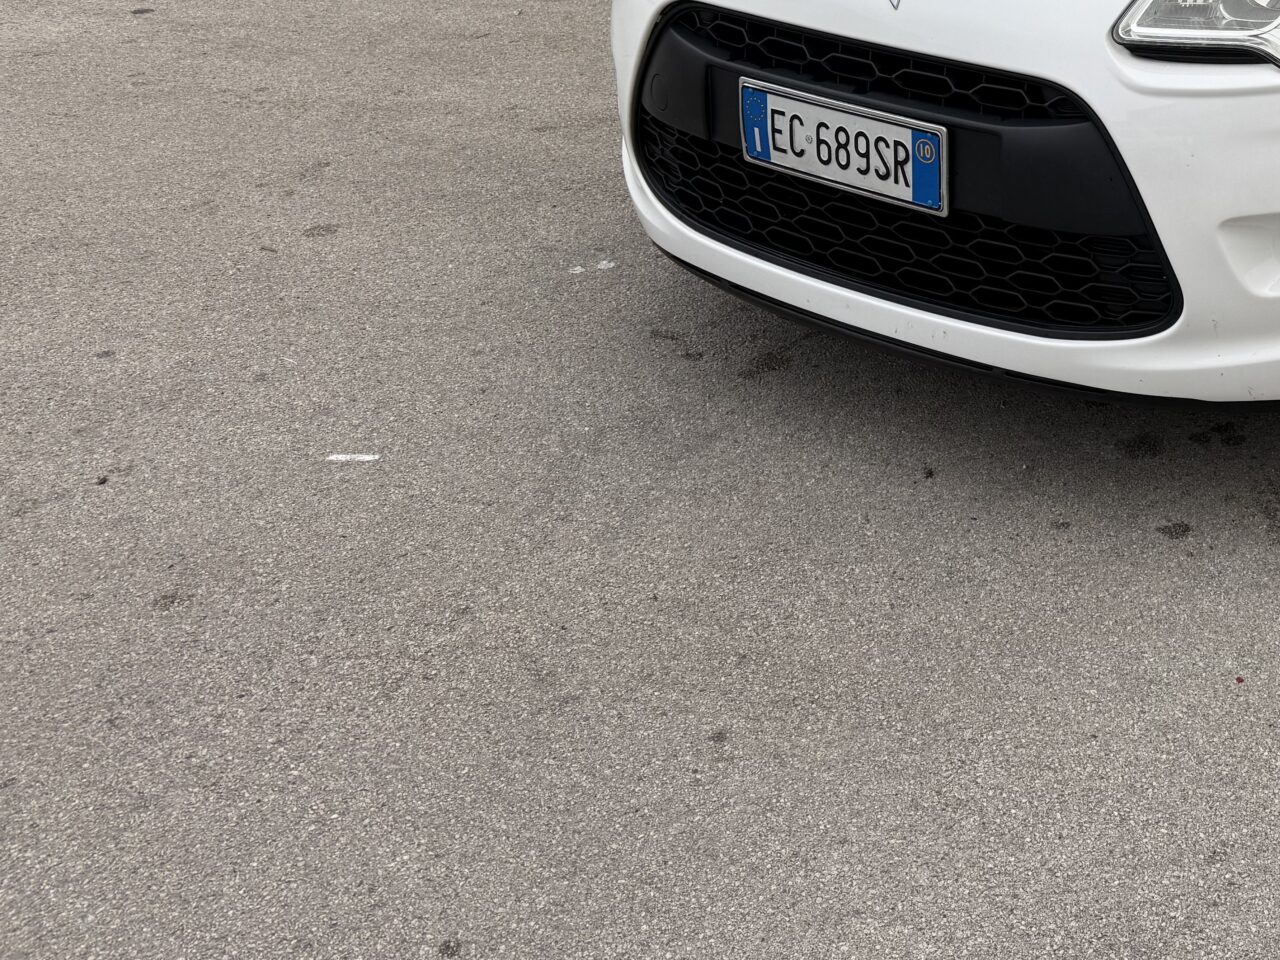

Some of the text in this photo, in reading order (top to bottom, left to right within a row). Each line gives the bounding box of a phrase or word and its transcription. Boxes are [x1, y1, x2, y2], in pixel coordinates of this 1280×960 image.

[753, 127, 762, 152] I
[771, 108, 911, 188] EC 689SR
